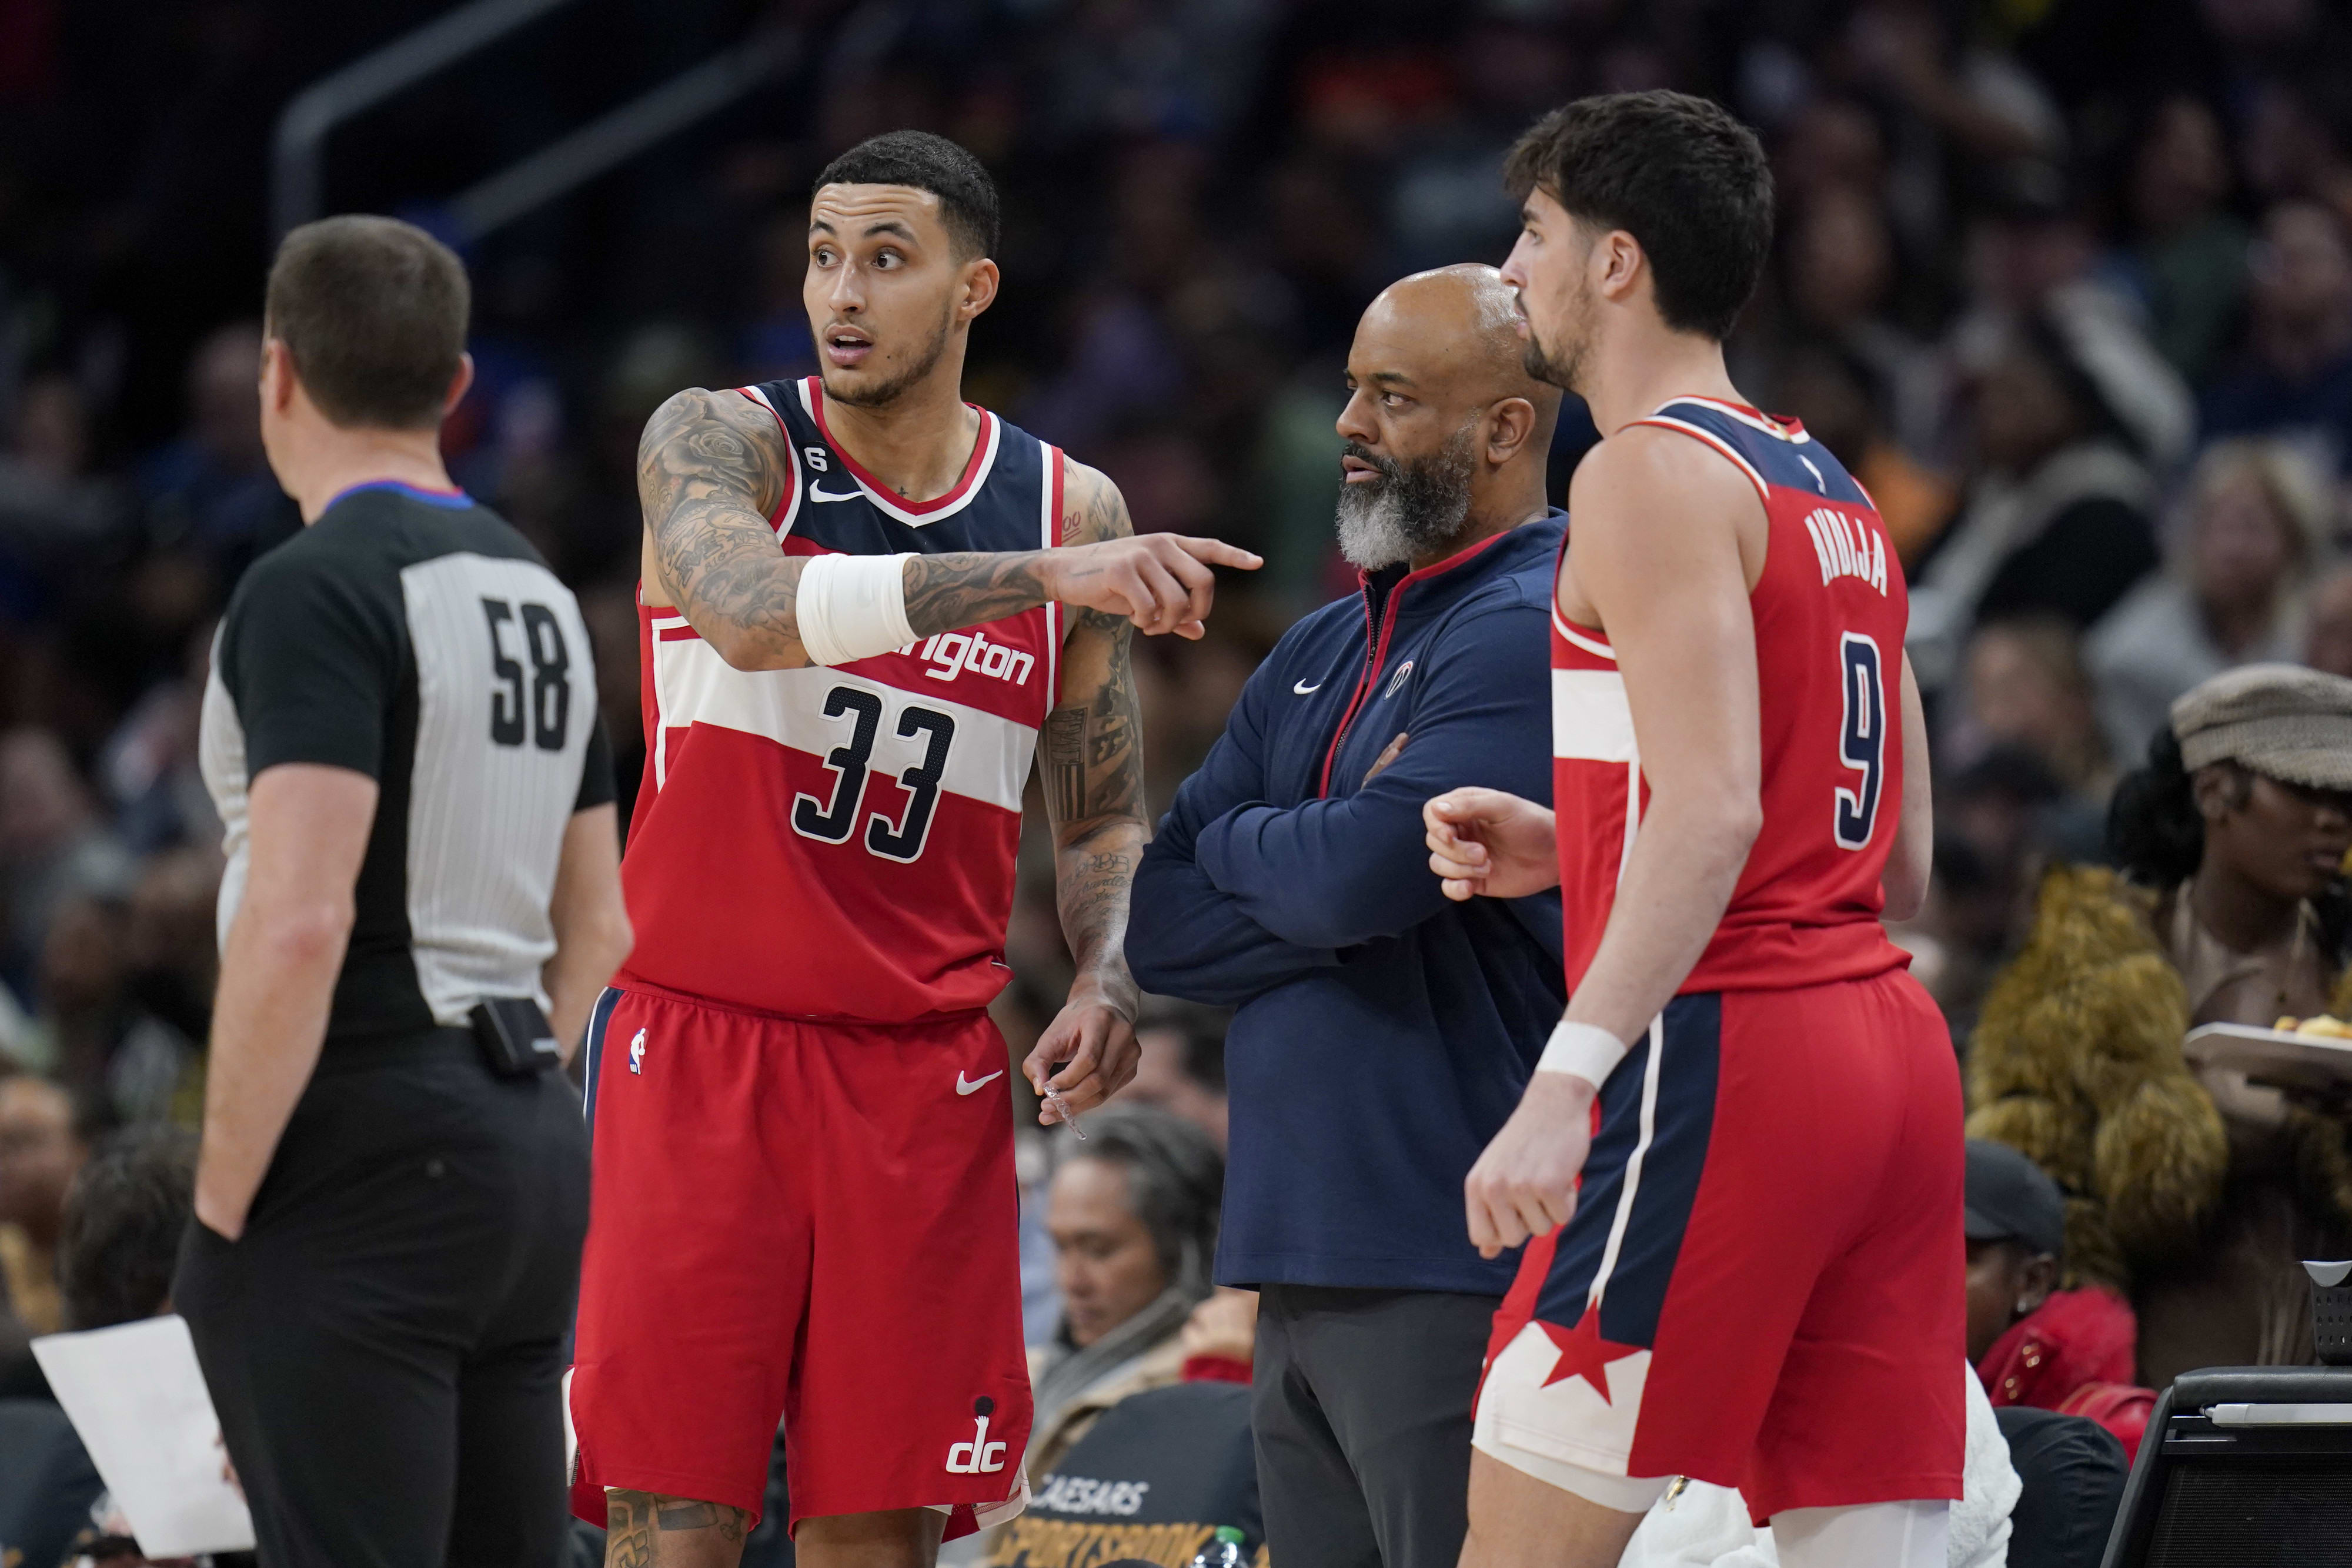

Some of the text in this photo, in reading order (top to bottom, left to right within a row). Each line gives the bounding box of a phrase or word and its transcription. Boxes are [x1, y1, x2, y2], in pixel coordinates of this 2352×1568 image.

[804, 447, 828, 472] 6
[481, 597, 570, 752] 58
[890, 632, 1035, 686] ngton
[790, 681, 960, 864] 33
[1834, 630, 1886, 851] 9
